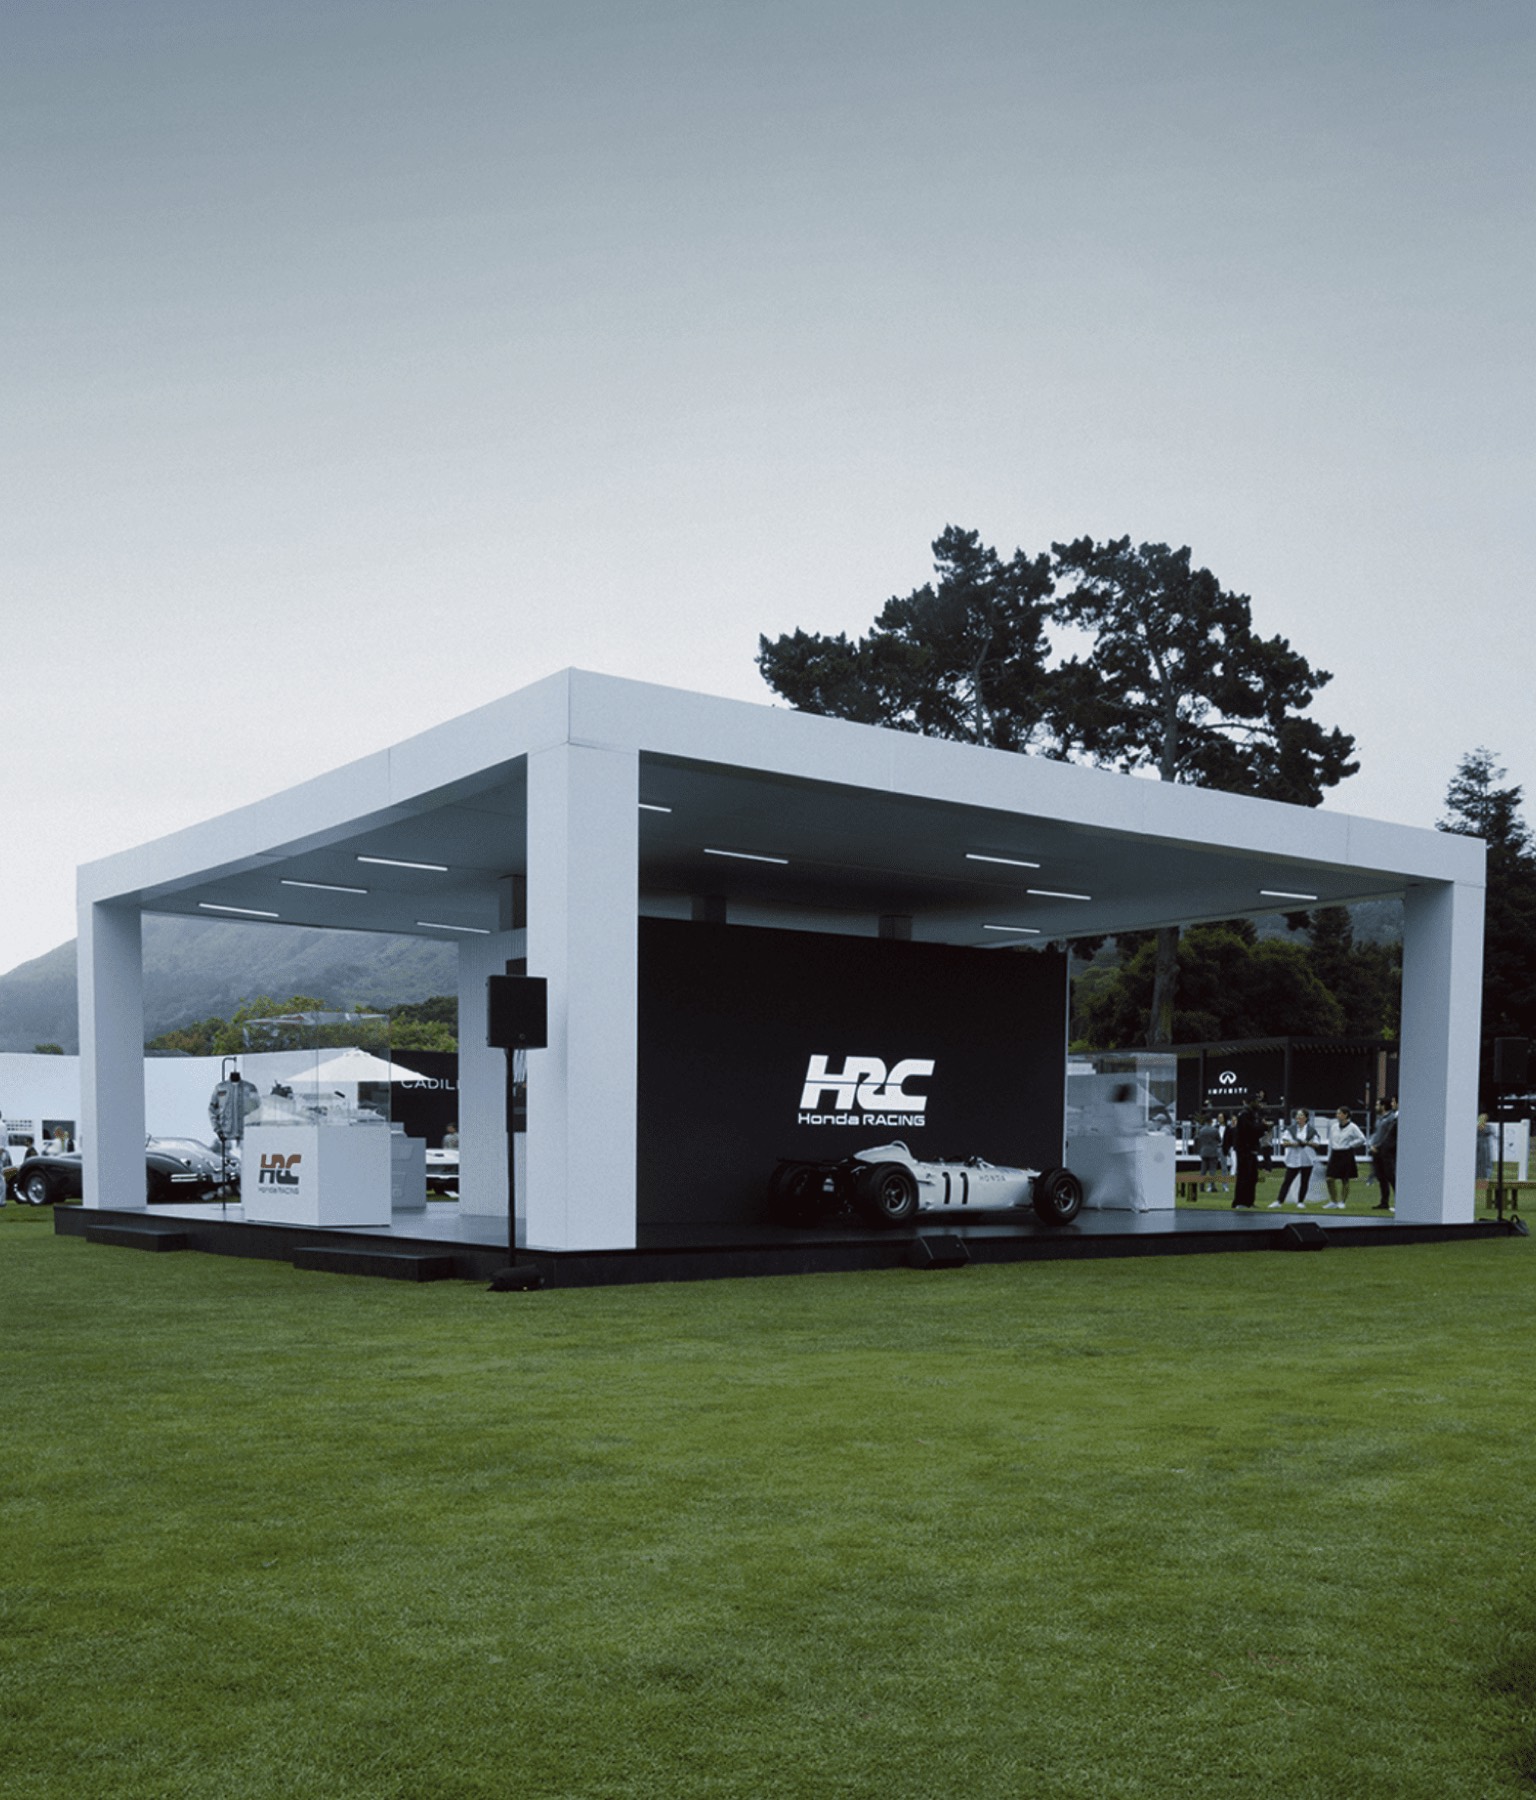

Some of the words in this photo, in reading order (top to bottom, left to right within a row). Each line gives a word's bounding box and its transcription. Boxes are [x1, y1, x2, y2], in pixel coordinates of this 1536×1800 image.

[401, 1078, 459, 1090] CADIL
[799, 1054, 936, 1111] HRC
[798, 1113, 860, 1126] Honda
[862, 1114, 926, 1127] RACING
[259, 1153, 302, 1185] HRC
[942, 1172, 969, 1205] 11
